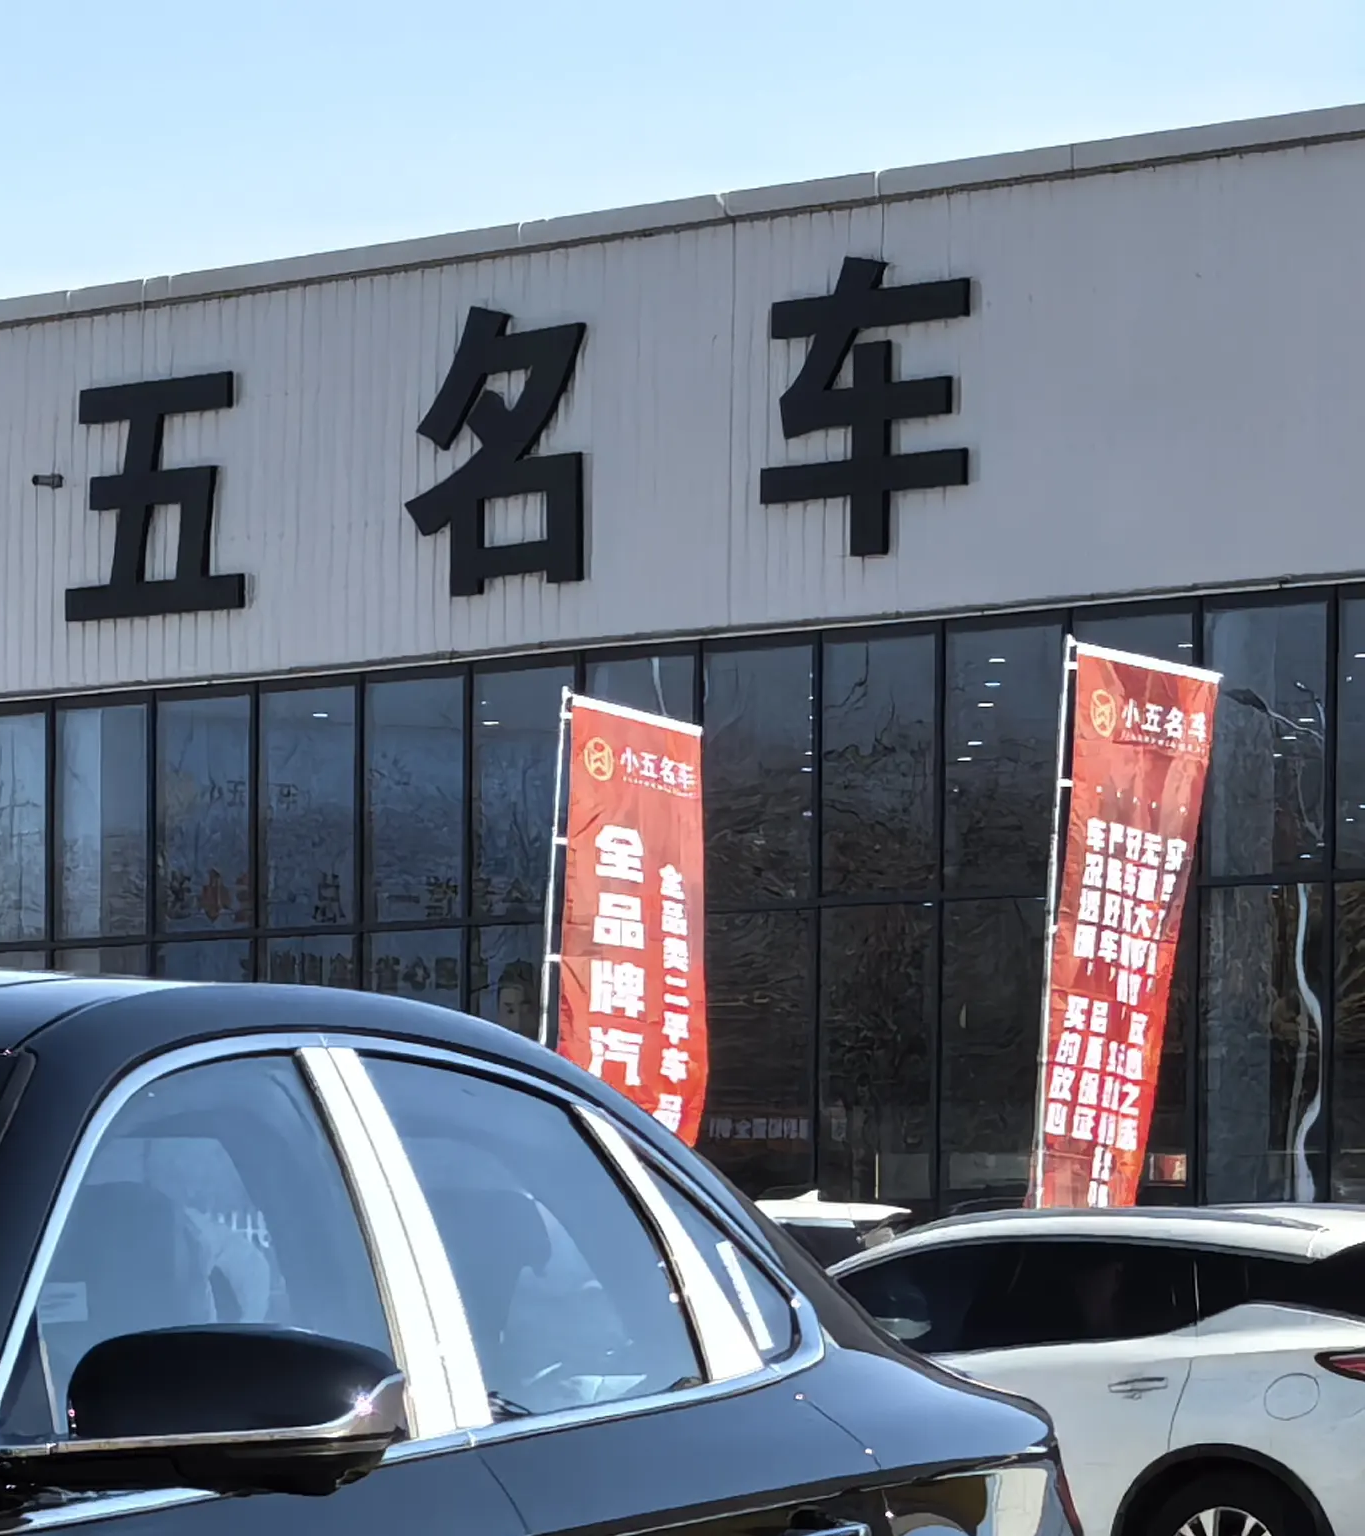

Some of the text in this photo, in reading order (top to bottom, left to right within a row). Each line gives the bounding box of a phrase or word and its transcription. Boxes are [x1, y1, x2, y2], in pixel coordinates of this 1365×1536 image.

[1120, 698, 1207, 743] 小五名车
[620, 746, 696, 789] 小五名车
[588, 824, 645, 1086] 全品牌汽
